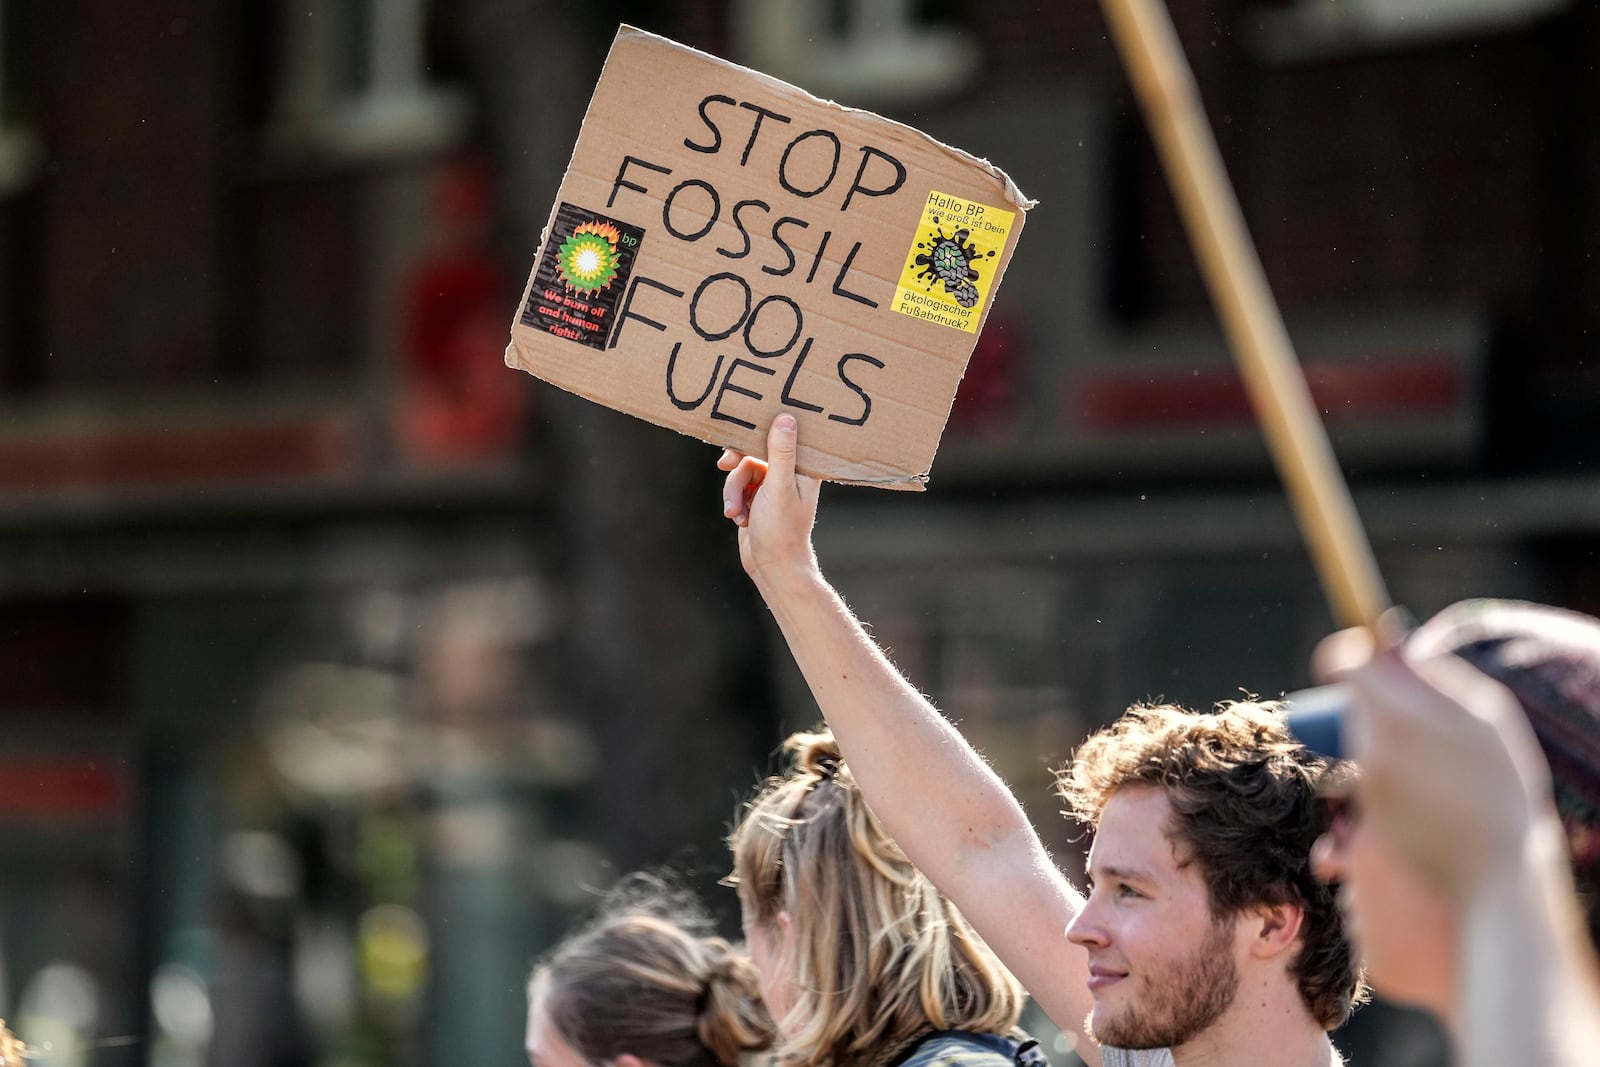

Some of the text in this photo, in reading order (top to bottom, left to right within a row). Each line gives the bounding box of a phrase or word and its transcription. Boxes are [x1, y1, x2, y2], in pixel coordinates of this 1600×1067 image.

[684, 94, 907, 212] STOP
[928, 193, 985, 220] Hallo BP,
[606, 155, 879, 309] FOSSIL
[928, 207, 1006, 235] wie groß ist Dein
[621, 232, 637, 247] bp
[544, 289, 605, 318] We burn oil
[900, 302, 969, 330] Fußabdruck?
[903, 291, 973, 319] ökologischer
[538, 305, 600, 332] and human
